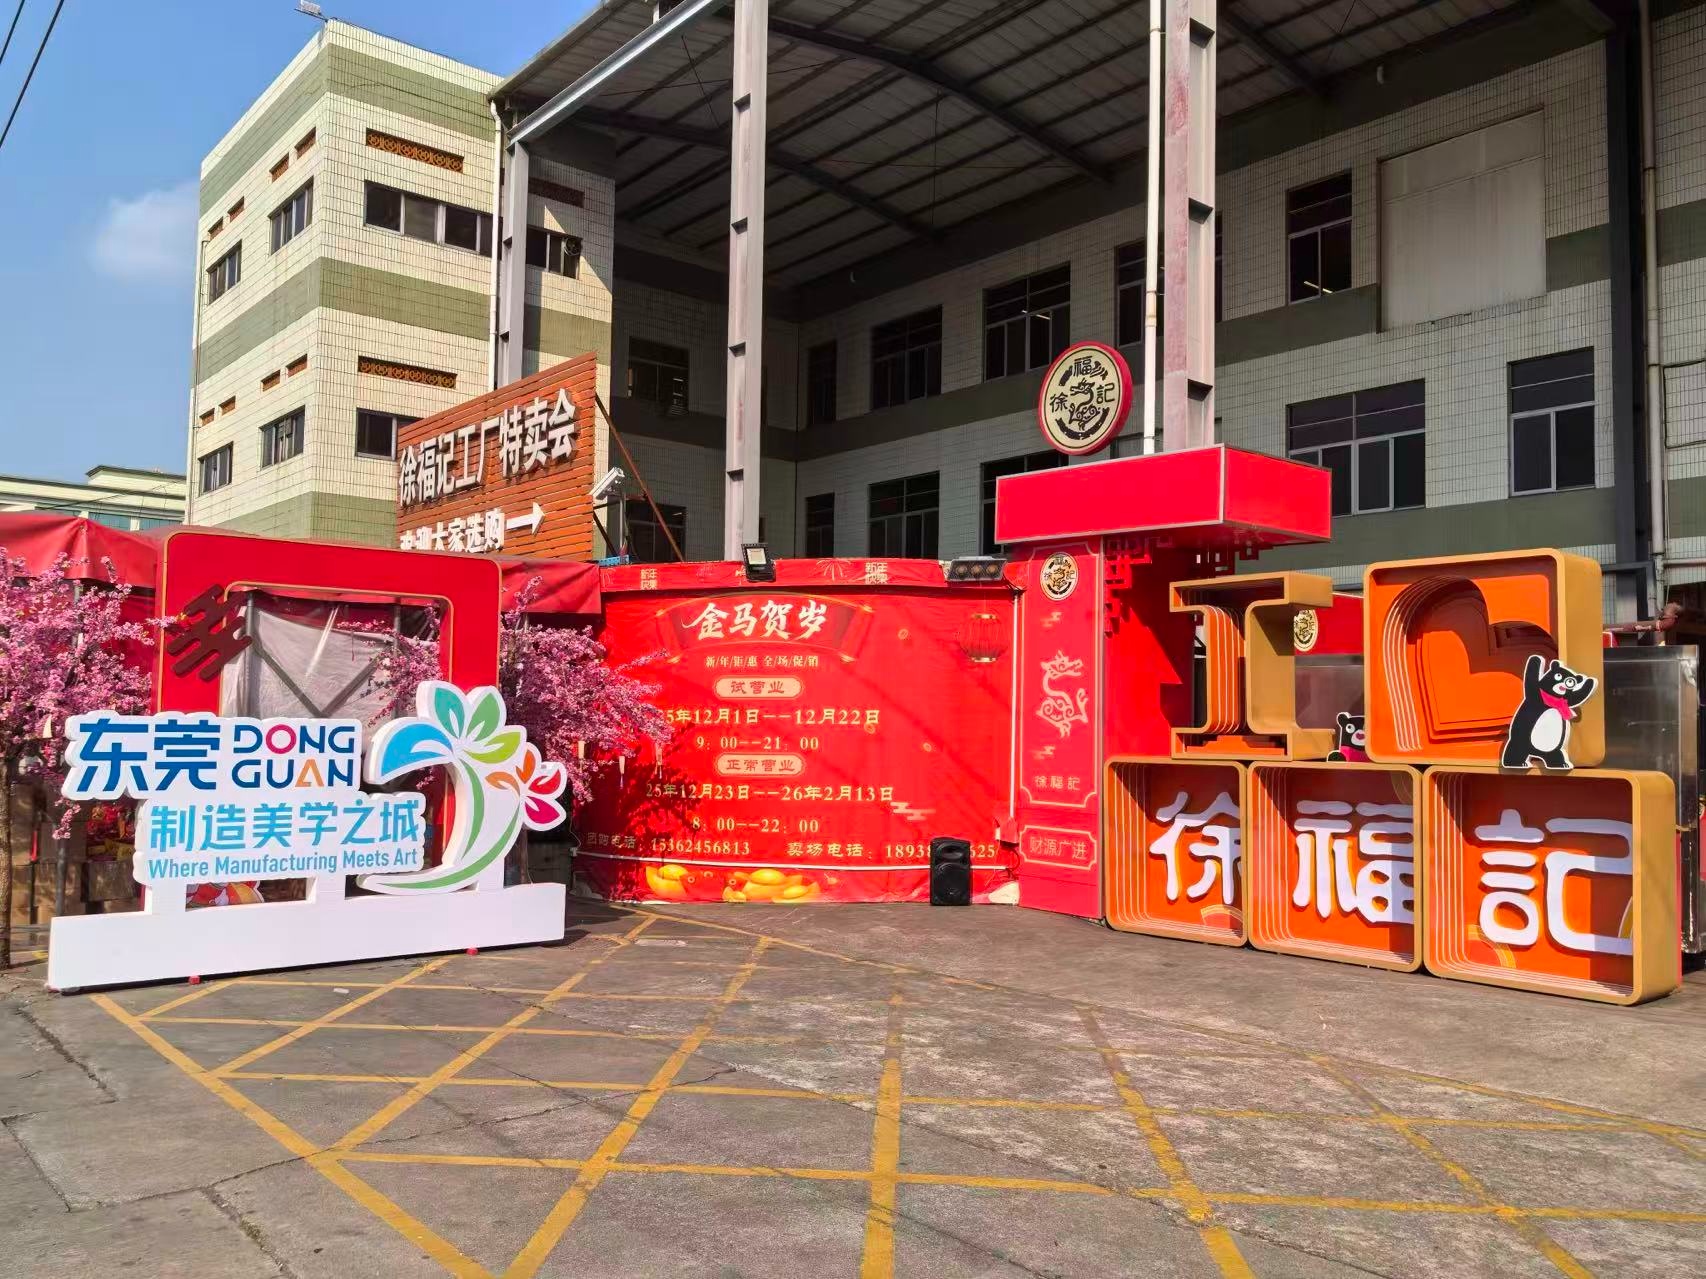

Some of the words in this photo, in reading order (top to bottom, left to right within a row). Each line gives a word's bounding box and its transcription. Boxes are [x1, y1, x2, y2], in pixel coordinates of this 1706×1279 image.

[399, 388, 576, 506] 徐福记工厂特卖会
[681, 599, 828, 641] 金马贺岁
[730, 680, 785, 694] 试营业
[77, 718, 221, 792] 东莞
[233, 724, 355, 754] DONG
[725, 758, 796, 772] 正常营业
[231, 759, 353, 789] GUAN
[150, 799, 419, 852] 制造美学之城
[149, 858, 209, 879] Where
[215, 853, 337, 876] Manufacturing
[343, 849, 389, 870] Meets
[394, 848, 417, 866] Art
[1029, 836, 1087, 860] 财源广进
